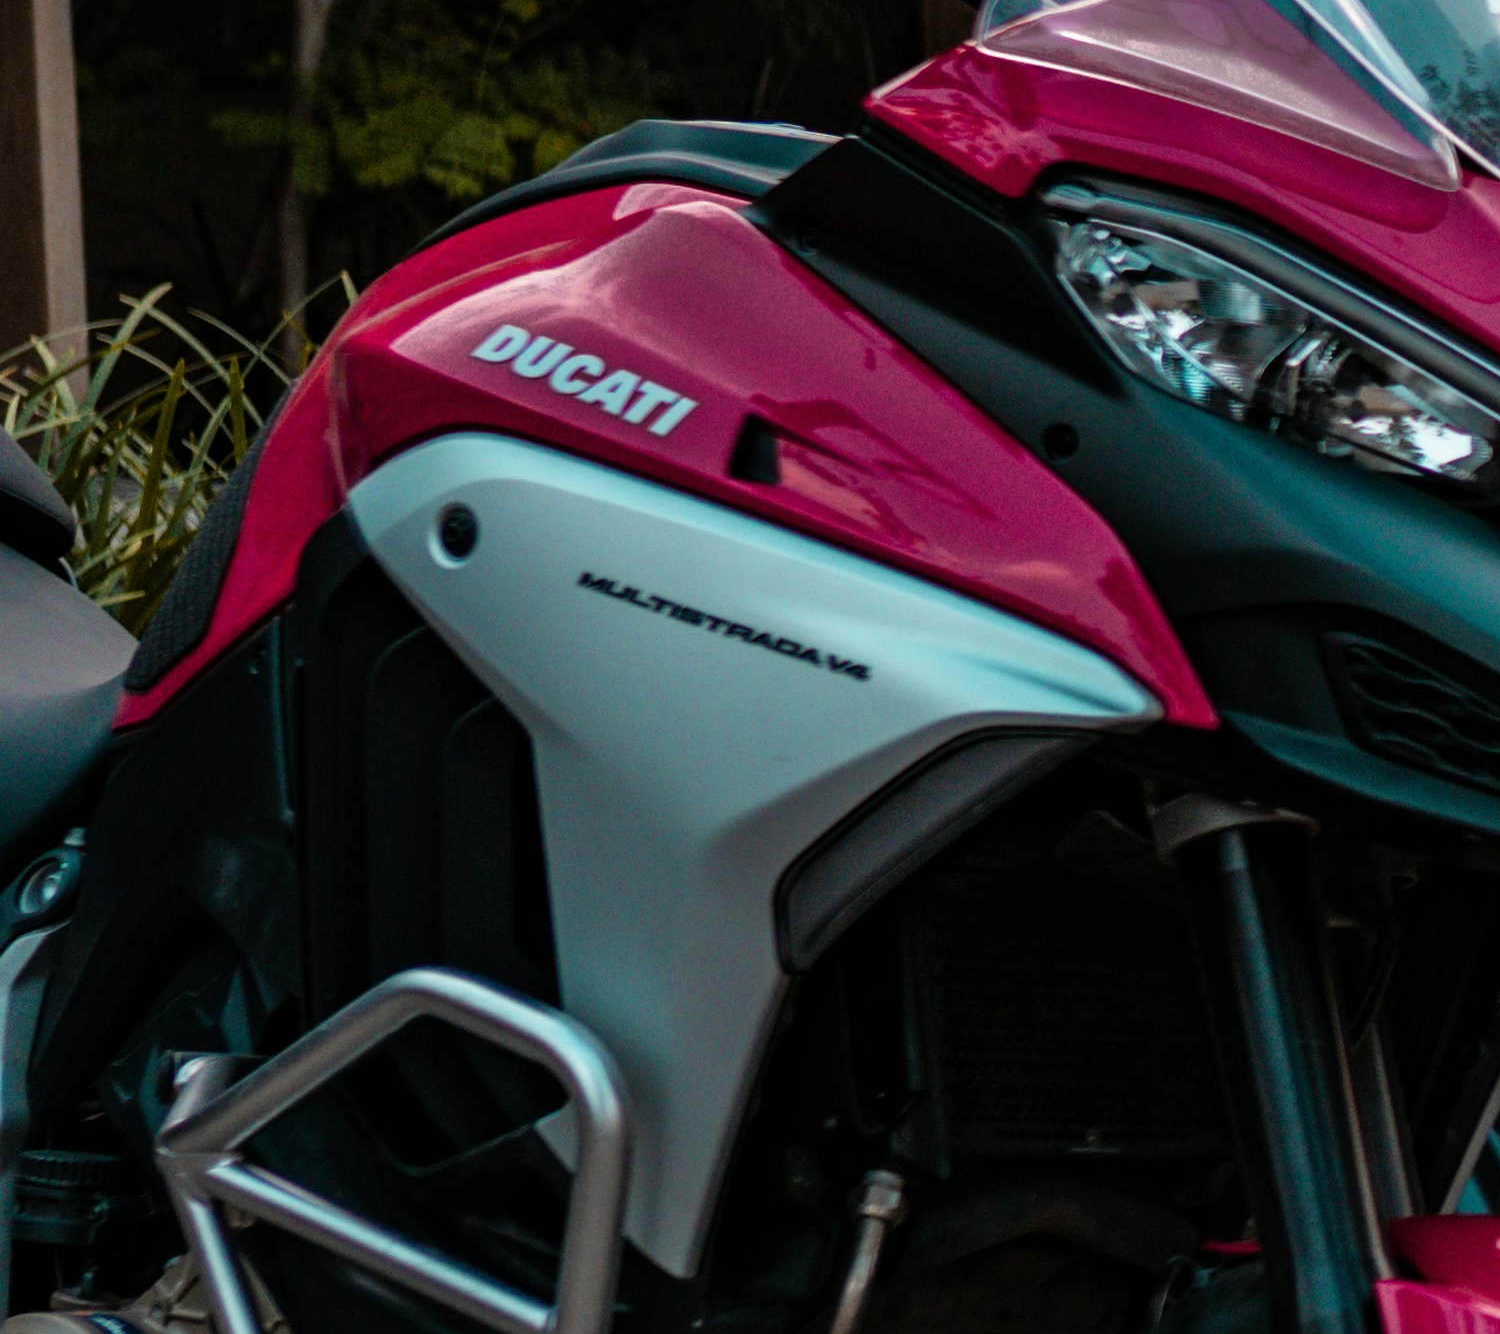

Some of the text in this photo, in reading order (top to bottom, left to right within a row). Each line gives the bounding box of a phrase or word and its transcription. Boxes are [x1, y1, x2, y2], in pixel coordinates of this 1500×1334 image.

[470, 324, 700, 437] DUCATI
[577, 572, 872, 682] MULTISTRADA V4
